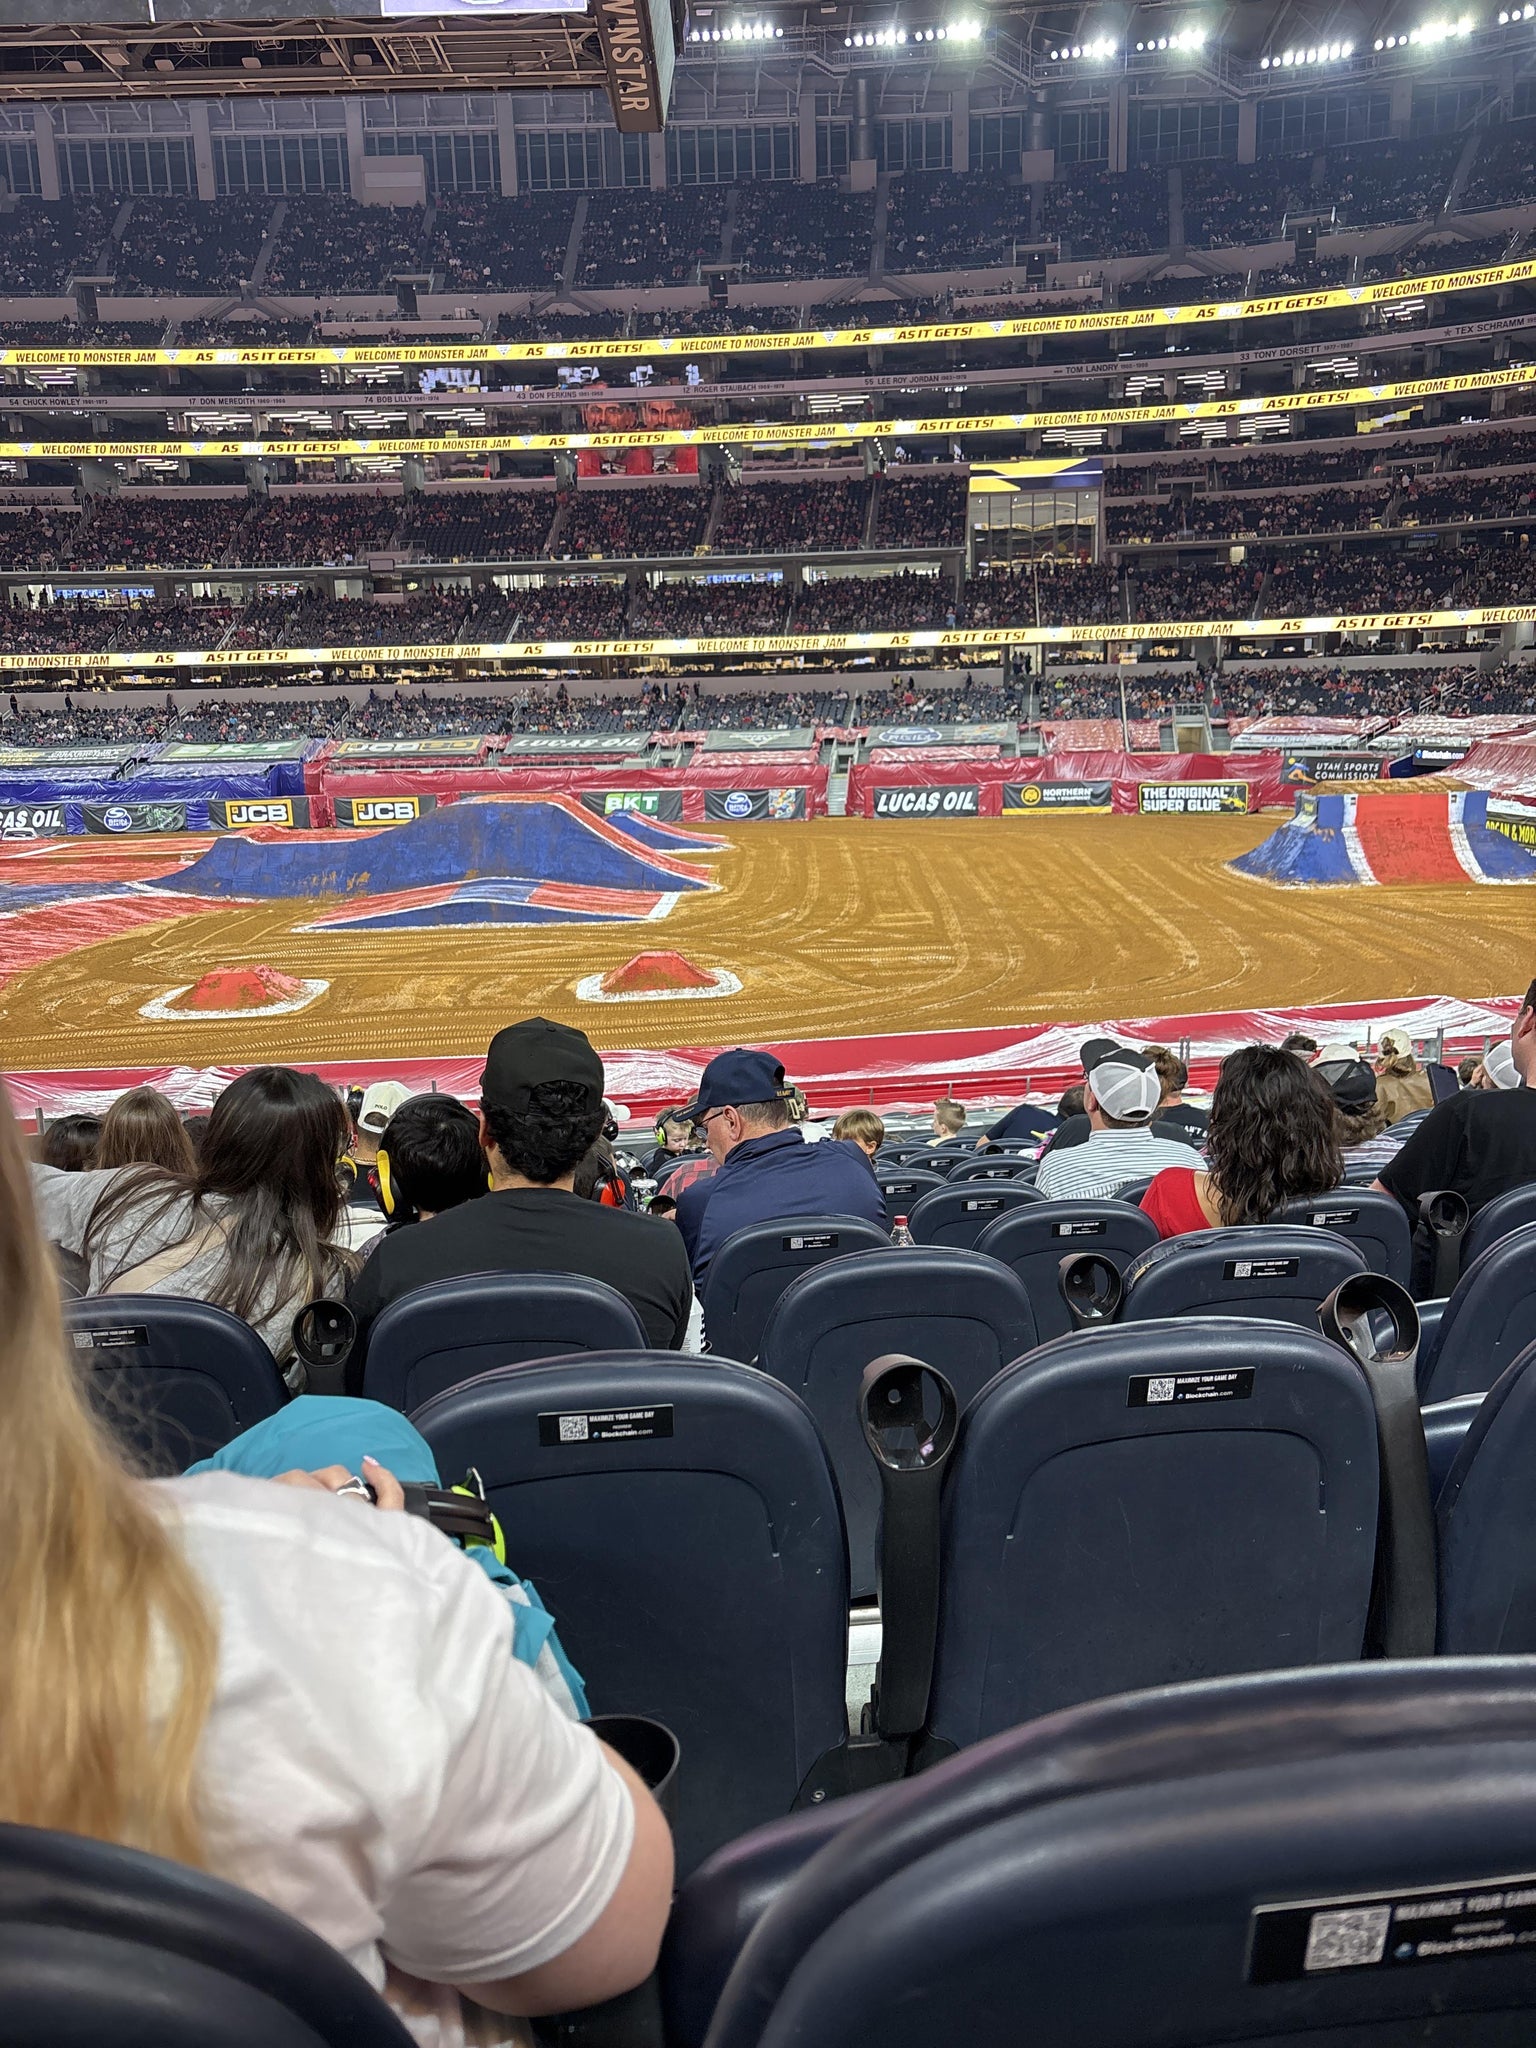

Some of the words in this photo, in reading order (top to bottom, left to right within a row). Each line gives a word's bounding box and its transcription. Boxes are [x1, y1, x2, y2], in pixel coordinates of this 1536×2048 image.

[1373, 281, 1428, 298] WELCOME
[1432, 279, 1444, 290] TO
[1448, 270, 1503, 288] MONSTER
[1506, 265, 1533, 279] JAM
[1196, 308, 1215, 318] AS
[1245, 303, 1265, 313] AS
[1266, 301, 1284, 311] IT
[1286, 296, 1329, 308] GETS!
[1013, 321, 1061, 332] WELCOME
[1065, 319, 1076, 329] TO
[1080, 316, 1128, 327] MONSTER
[1132, 313, 1154, 324] JAM
[1455, 325, 1474, 335] TEX
[1477, 318, 1524, 331] SCHRAMM
[853, 333, 871, 342] AS
[898, 331, 916, 339] AS
[917, 330, 932, 338] IT
[935, 327, 973, 337] GETS!
[570, 346, 588, 354] AS
[606, 344, 643, 353] GETS!
[682, 340, 727, 350] WELCOME
[731, 340, 741, 348] TO
[745, 338, 790, 347] MONSTER
[793, 336, 814, 346] JAM
[15, 353, 66, 362] WELCOME
[69, 353, 80, 362] TO
[84, 353, 131, 362] MONSTER
[135, 353, 156, 362] JAM
[196, 353, 214, 361] AS
[242, 353, 259, 361] AS
[355, 351, 401, 360] WELCOME
[404, 350, 415, 359] TO
[419, 350, 464, 359] MONSTER
[468, 349, 488, 358] JAM
[1254, 350, 1277, 359] TONY
[1280, 346, 1321, 357] DORSETT
[1066, 366, 1083, 374] TOM
[1086, 364, 1118, 372] LANDRY
[910, 375, 939, 383] JORDAN
[1395, 381, 1449, 395] WELCOME
[1454, 378, 1467, 388] TO
[1471, 370, 1526, 386] MONSTER
[720, 384, 757, 392] STAUBACH
[9, 398, 19, 406] 54
[22, 398, 48, 406] CHUCK
[1217, 404, 1236, 413] AS
[1266, 399, 1286, 408] AS
[1289, 397, 1305, 406] IT
[1307, 392, 1350, 404] GETS!
[1035, 414, 1082, 425] WELCOME
[1086, 413, 1097, 422] TO
[1101, 410, 1149, 421] MONSTER
[1153, 408, 1175, 418] JAM
[957, 419, 994, 428] GETS!
[629, 435, 665, 443] GETS!
[704, 431, 749, 440] WELCOME
[767, 428, 811, 437] MONSTER
[815, 427, 836, 436] JAM
[42, 446, 90, 454] WELCOME
[110, 446, 156, 454] MONSTER
[161, 445, 182, 453] JAM
[380, 442, 424, 450] WELCOME
[443, 440, 487, 449] MONSTER
[491, 440, 511, 448] JAM
[1281, 622, 1300, 630] AS
[1336, 619, 1358, 628] AS
[1361, 618, 1377, 627] IT
[1383, 615, 1433, 626] GETS!
[1072, 628, 1127, 639] WELCOME
[1132, 627, 1145, 637] TO
[1149, 625, 1204, 636] MONSTER
[1208, 624, 1233, 634] JAM
[698, 641, 748, 650] WELCOME
[753, 641, 765, 649] TO
[769, 639, 819, 648] MONSTER
[823, 638, 847, 647] JAM
[332, 650, 382, 659] WELCOME
[388, 650, 400, 658] TO
[404, 648, 454, 657] MONSTER
[457, 647, 481, 656] JAM
[11, 658, 24, 666] TO
[28, 657, 81, 666] MONSTER
[86, 656, 110, 665] JAM
[1316, 762, 1341, 771] UTAH
[1344, 762, 1380, 771] SPORTS
[1314, 771, 1378, 780] COMMISSION
[1043, 788, 1092, 796] NORTHERN
[1142, 787, 1167, 799] THE
[1168, 786, 1225, 798] ORIGINAL
[607, 796, 658, 811] BKT
[877, 792, 940, 812] LUCAS
[1142, 800, 1184, 812] SUPER
[1187, 799, 1221, 812] GLUE
[232, 804, 288, 822] JCB
[358, 802, 414, 820] JCB
[1512, 824, 1518, 842] &
[1519, 825, 1536, 844] MOR
[1186, 1390, 1233, 1399] Blockchain.com
[616, 1413, 629, 1421] YOUR
[630, 1412, 644, 1420] GAME
[601, 1429, 653, 1438] Blockchain.com
